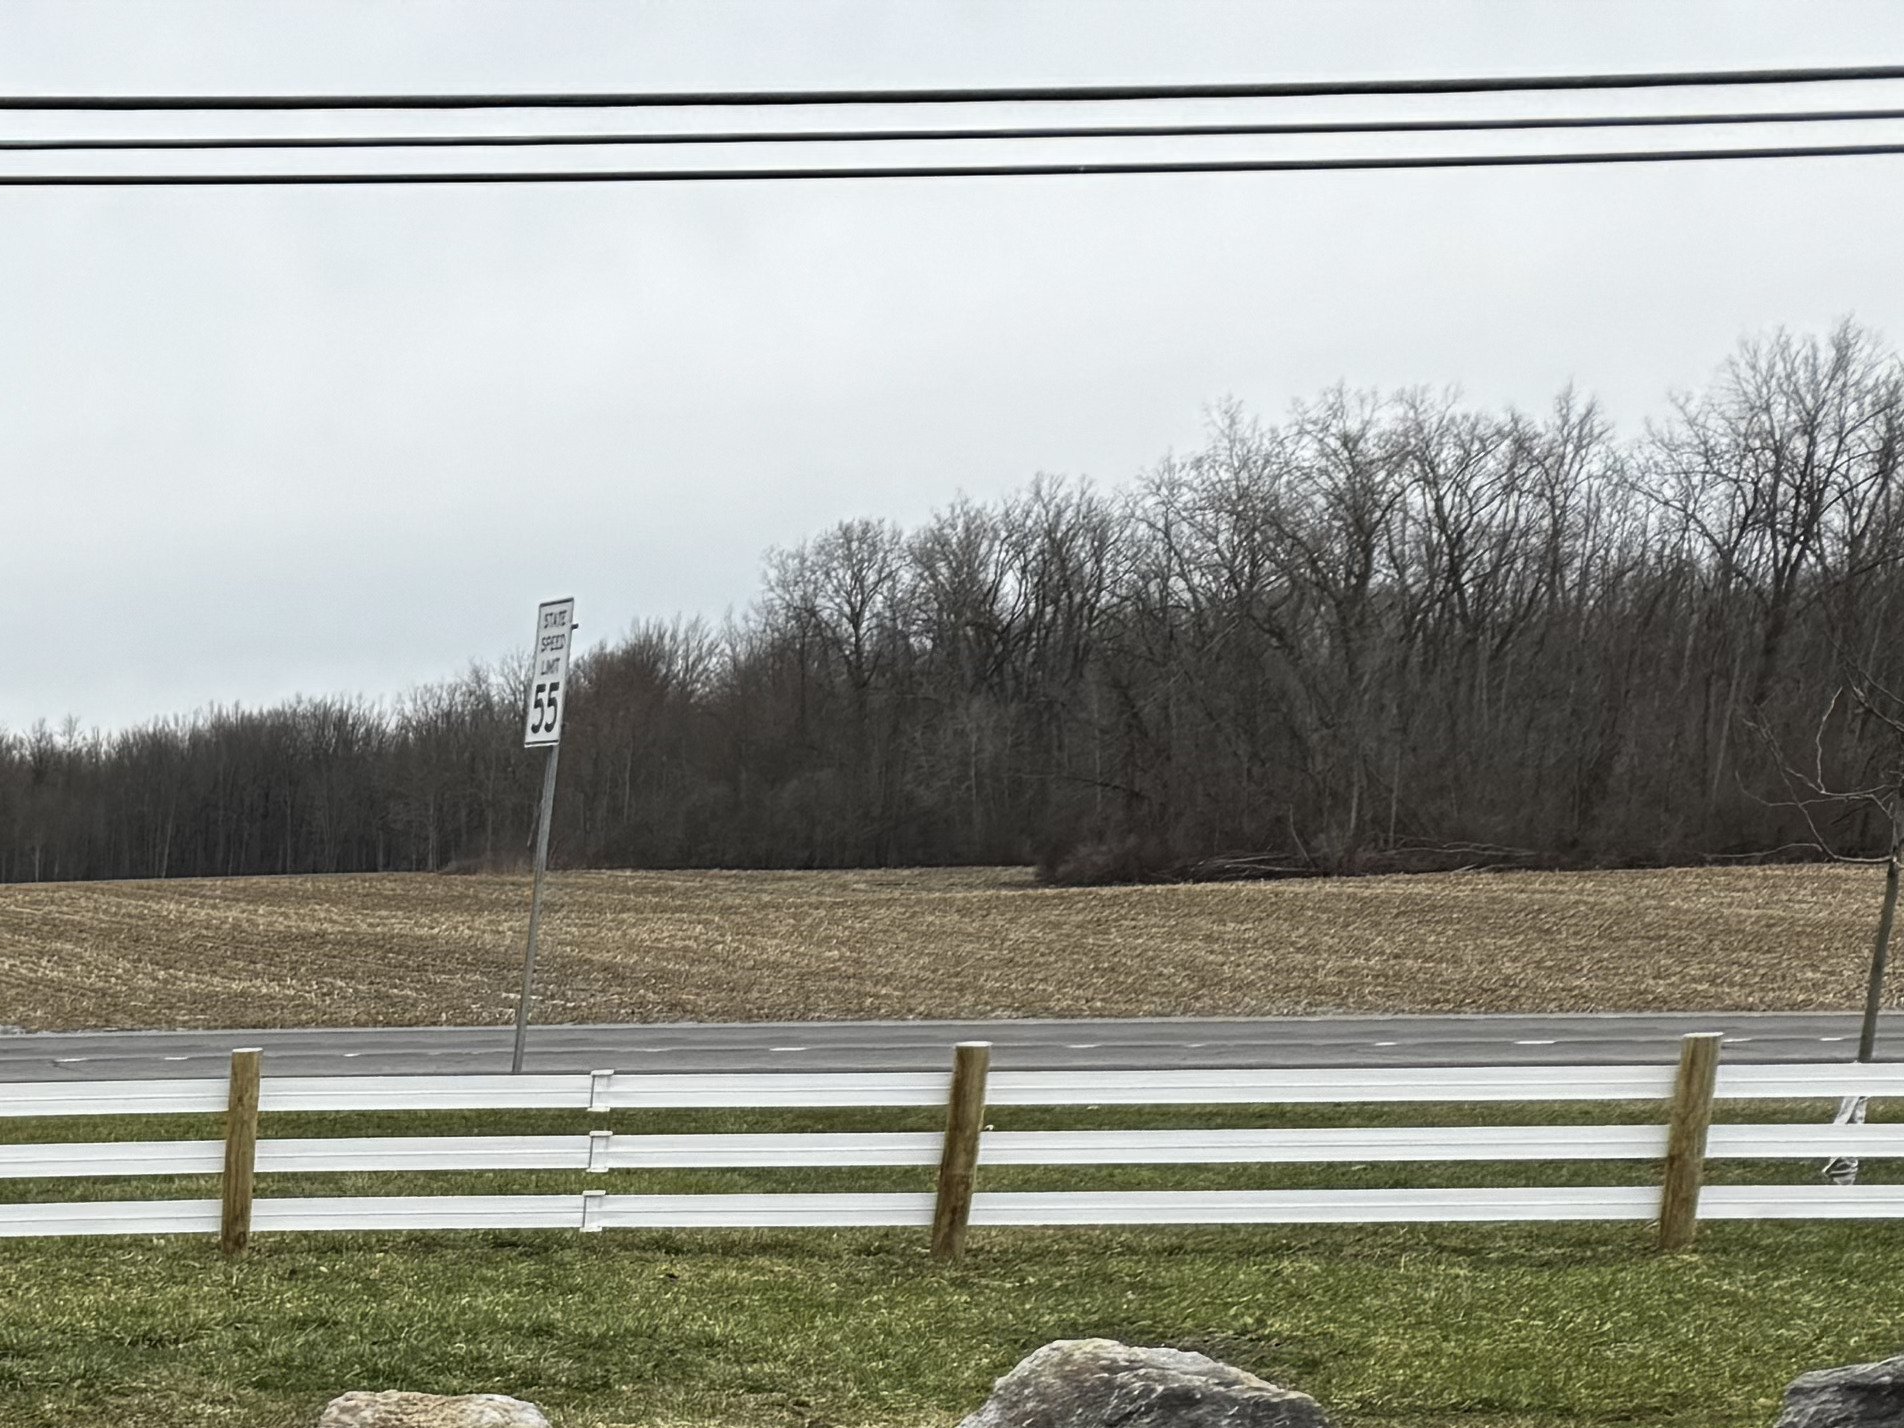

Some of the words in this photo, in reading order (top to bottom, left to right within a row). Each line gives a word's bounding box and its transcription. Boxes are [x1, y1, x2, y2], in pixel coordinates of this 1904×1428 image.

[544, 610, 567, 628] STATE
[541, 634, 566, 652] SPEED
[540, 657, 560, 675] LIMIT
[531, 681, 560, 733] 55
